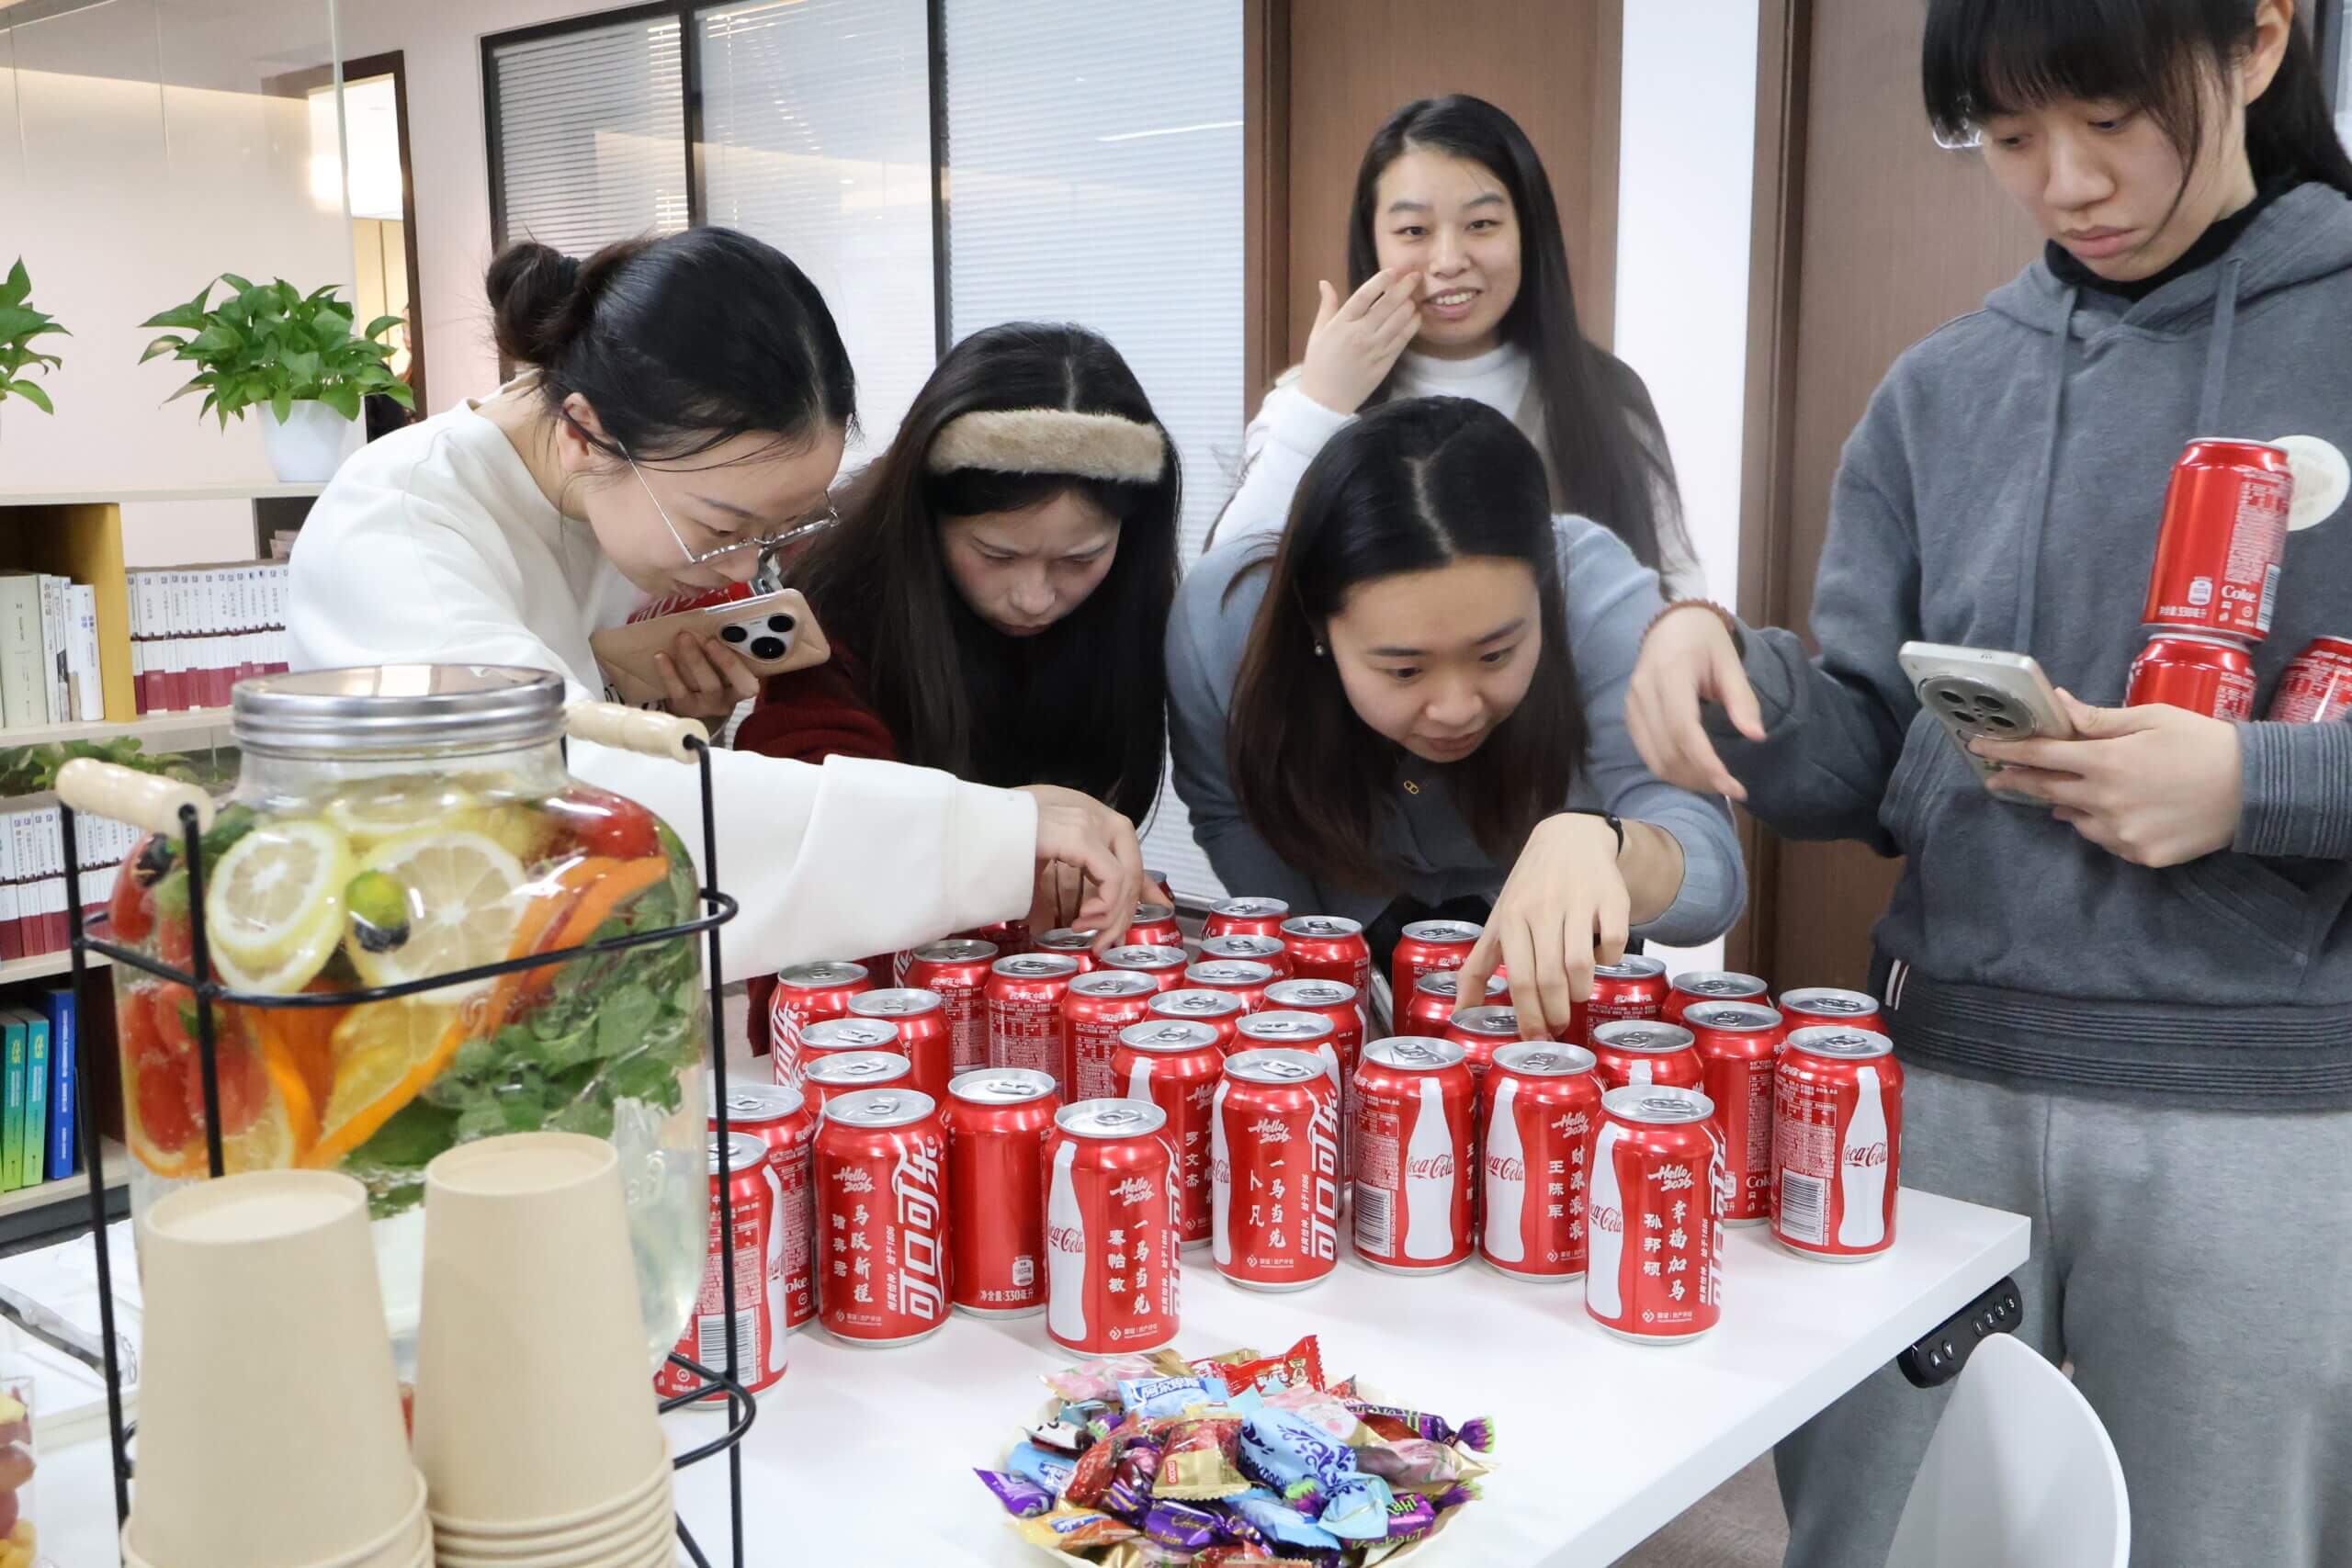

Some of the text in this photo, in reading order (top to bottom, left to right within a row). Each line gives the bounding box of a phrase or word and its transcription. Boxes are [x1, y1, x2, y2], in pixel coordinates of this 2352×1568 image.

[2221, 584, 2257, 603] Coke
[1249, 1118, 1285, 1135] Hello
[1551, 1111, 1587, 1130] Hello
[1260, 1131, 1293, 1145] 2026
[832, 1166, 869, 1182] Hello
[1647, 1163, 1688, 1181] Hello
[842, 1179, 875, 1192] 2026
[1110, 1176, 1149, 1194] Hello
[1546, 1160, 1566, 1219] 王陈军
[1660, 1177, 1695, 1192] 2026
[1122, 1190, 1155, 1206] 2026
[1249, 1169, 1265, 1228] 卜凡
[1268, 1159, 1287, 1248] 一马当先
[893, 1132, 941, 1320] 可口可乐
[851, 1203, 875, 1303] 马跃新程
[1668, 1199, 1689, 1302] 幸福加马
[1133, 1219, 1151, 1315] 一马当先
